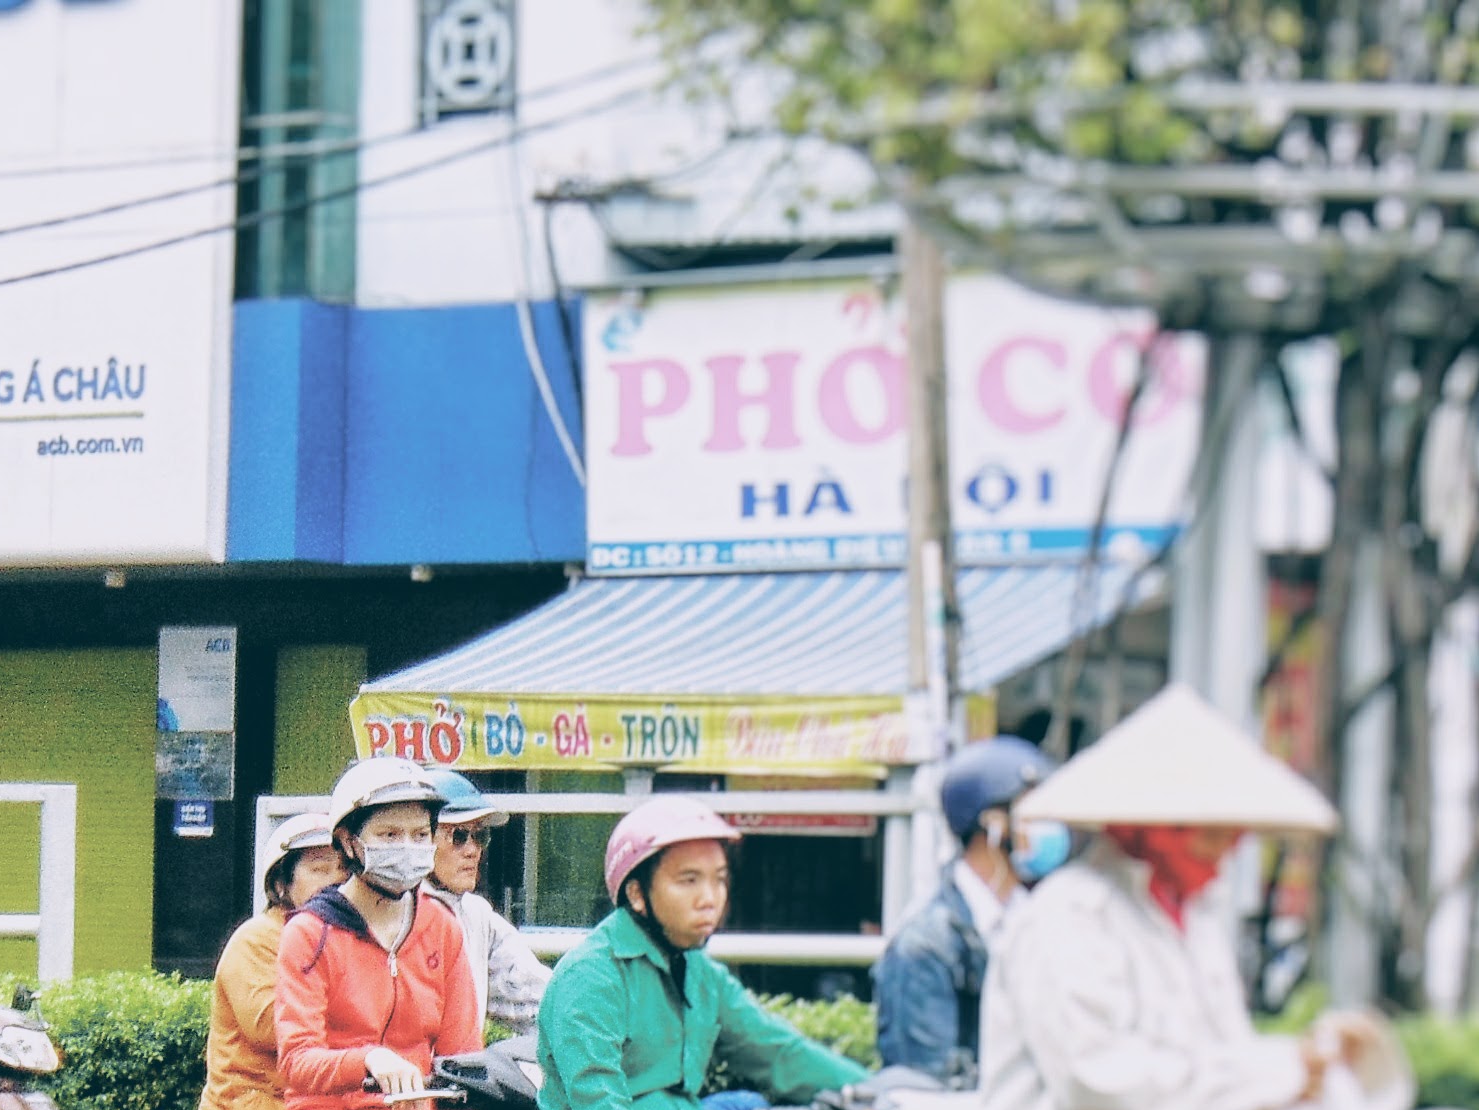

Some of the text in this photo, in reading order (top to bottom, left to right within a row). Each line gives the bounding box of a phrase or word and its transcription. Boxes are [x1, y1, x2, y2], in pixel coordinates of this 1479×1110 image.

[22, 357, 45, 403] Á
[52, 356, 147, 402] CHÂU
[36, 434, 145, 457] acb.com.vn
[740, 465, 853, 518] HÀ
[363, 702, 464, 765] PHỞ
